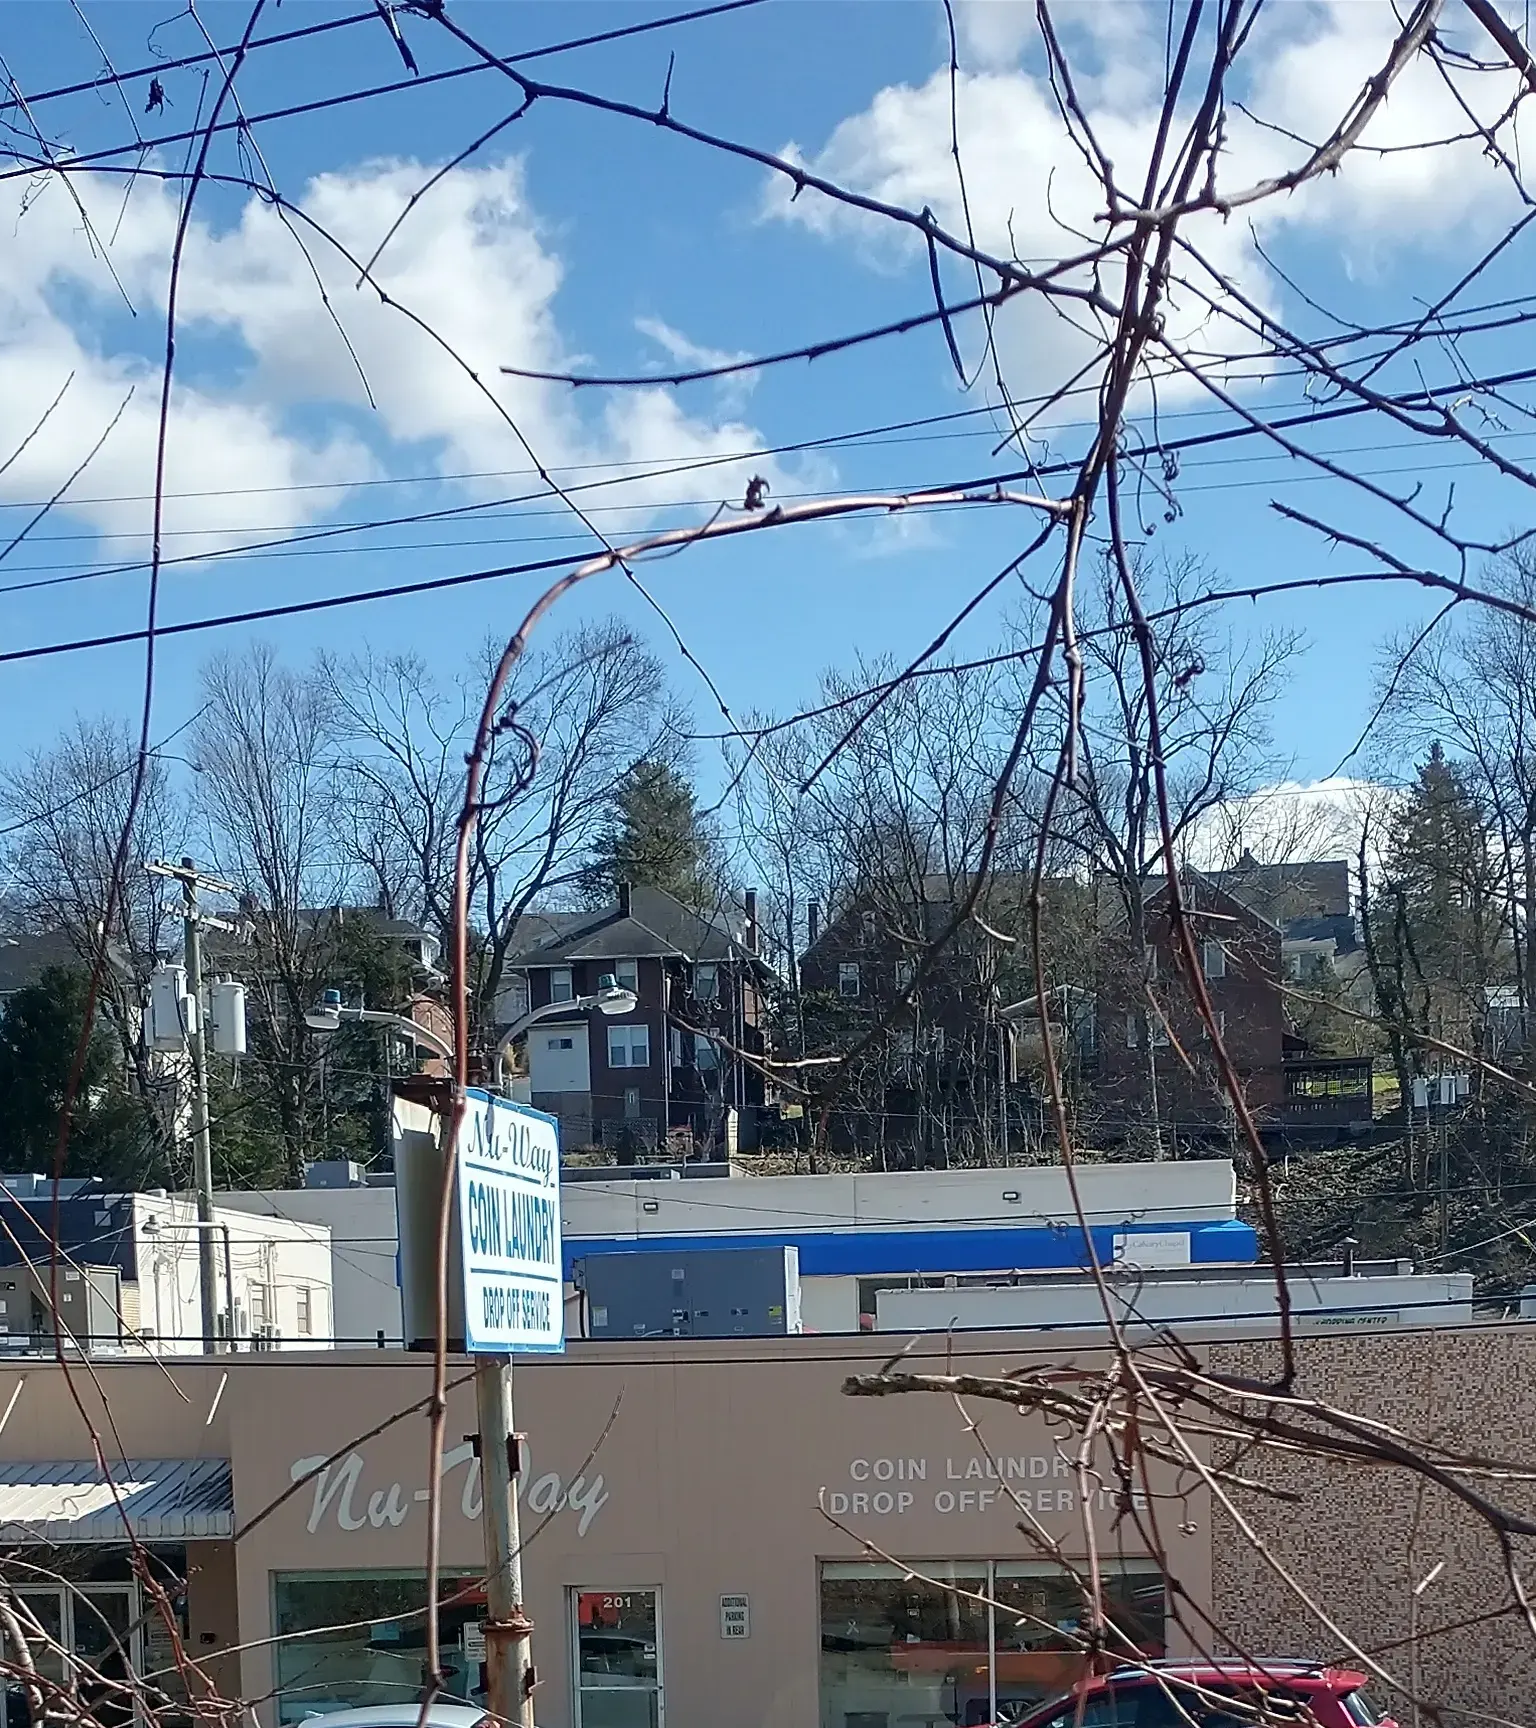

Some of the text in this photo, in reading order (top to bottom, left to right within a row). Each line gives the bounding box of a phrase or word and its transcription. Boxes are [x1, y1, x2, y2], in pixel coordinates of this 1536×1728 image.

[468, 1111, 553, 1188] Nu-Way
[469, 1180, 555, 1265] COIN LAUNDRY
[482, 1286, 551, 1332] DROP OFF SERVICE
[849, 1457, 928, 1482] COIN
[946, 1455, 1090, 1481] LAUNDR
[830, 1491, 915, 1515] DROP
[934, 1490, 996, 1514] OFF
[603, 1596, 632, 1609] 201
